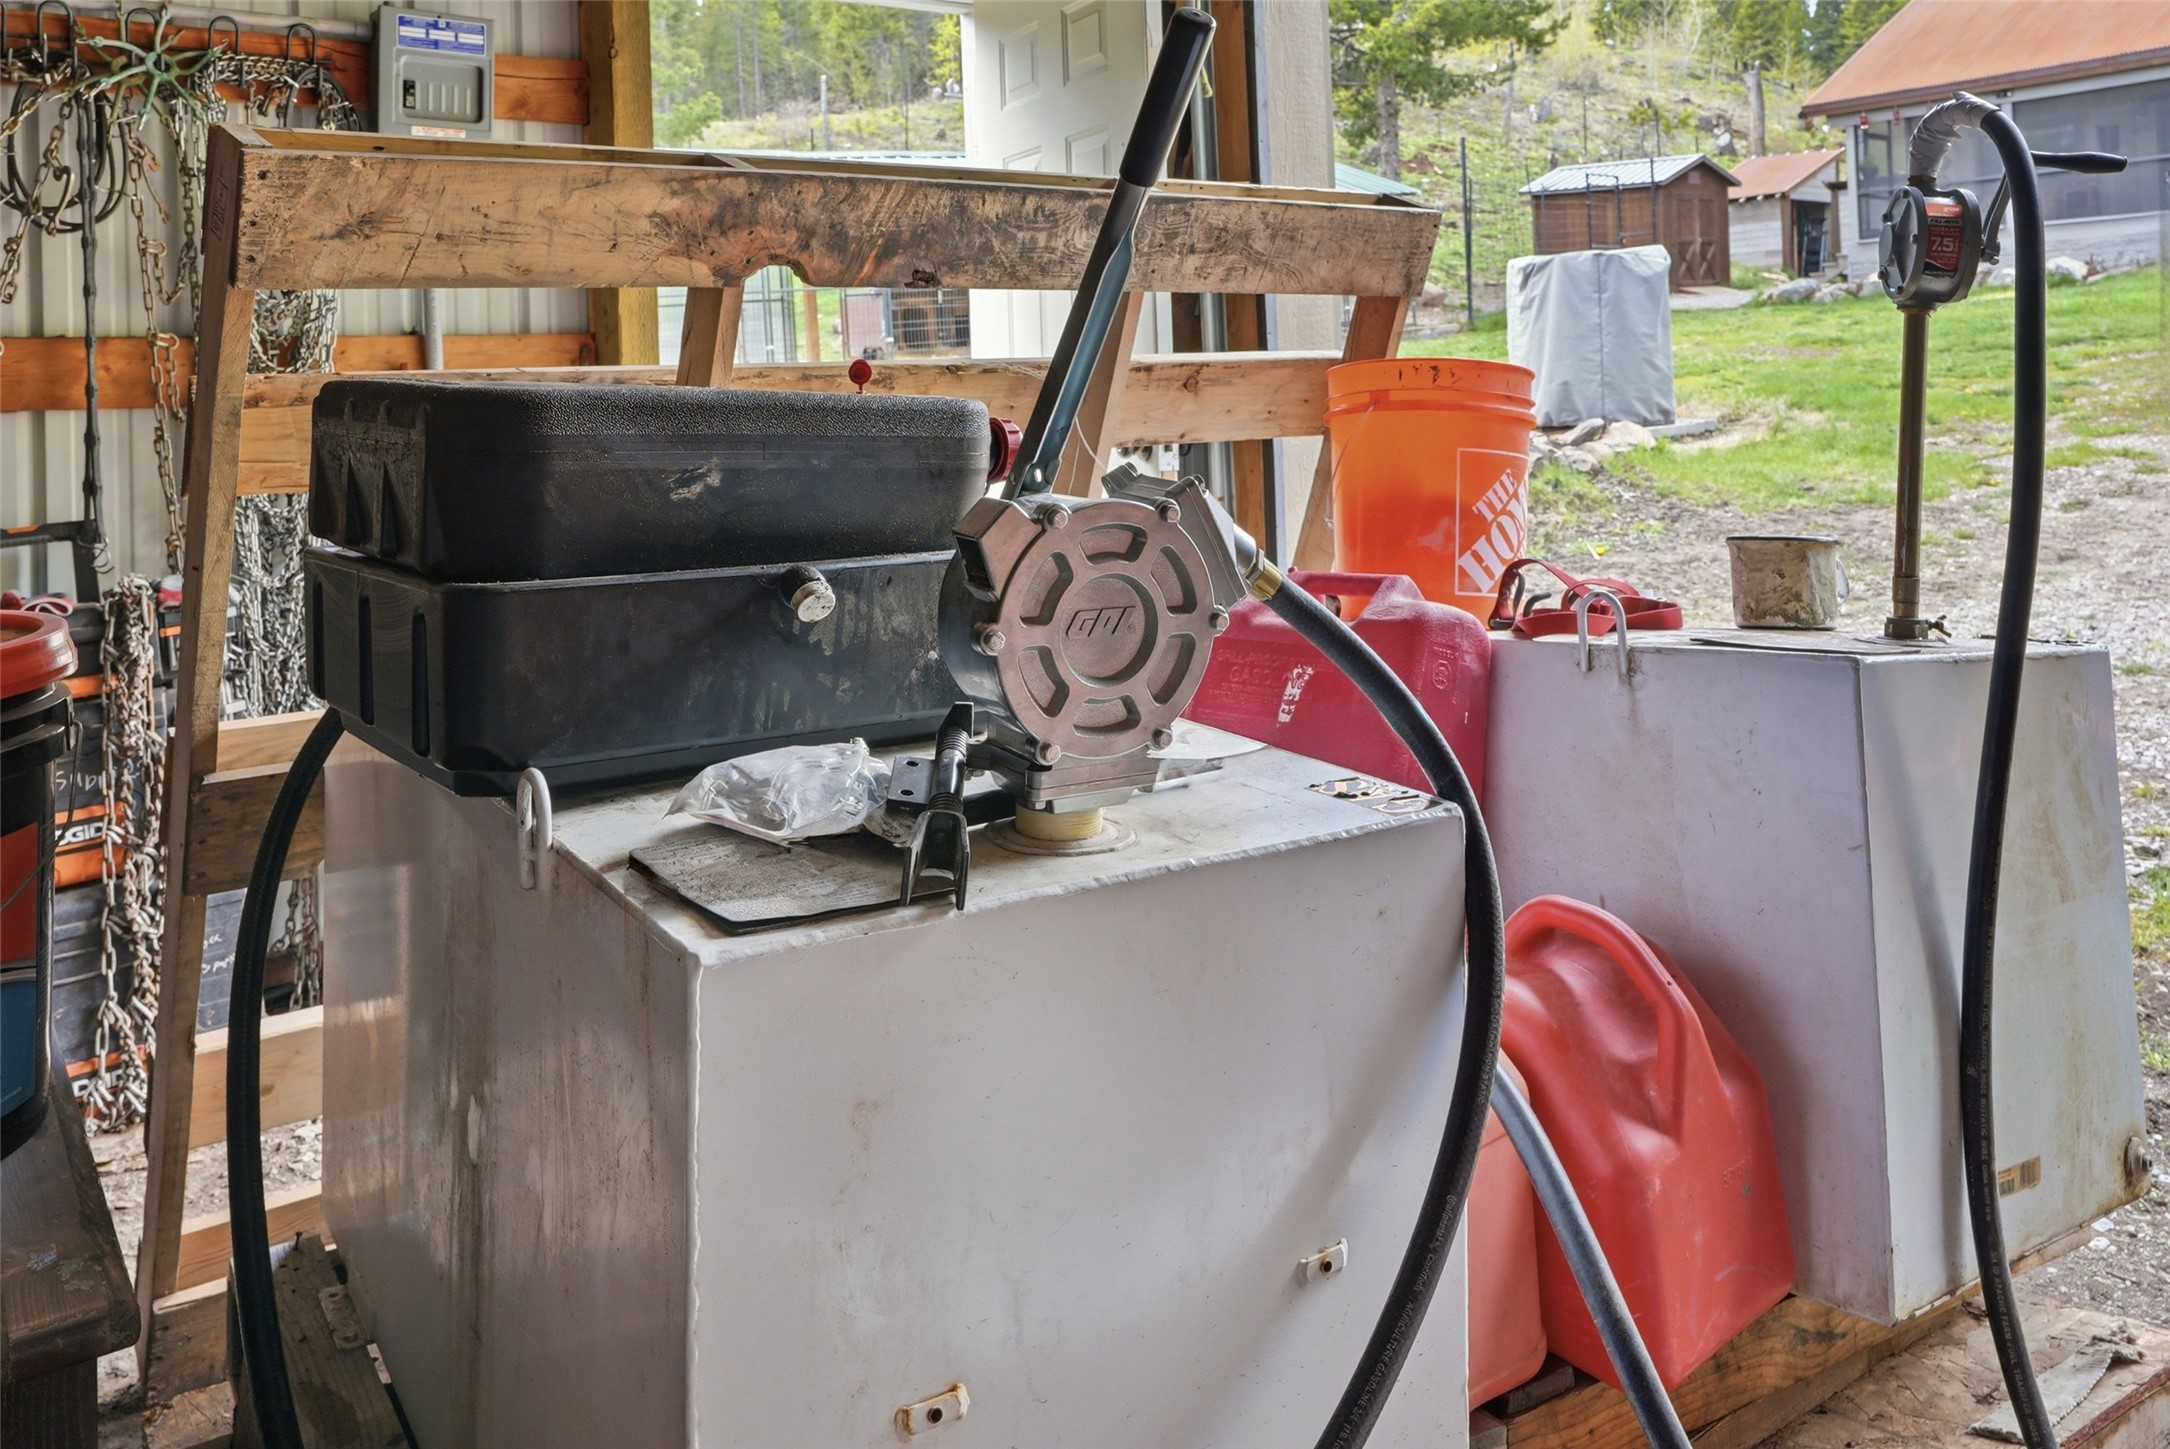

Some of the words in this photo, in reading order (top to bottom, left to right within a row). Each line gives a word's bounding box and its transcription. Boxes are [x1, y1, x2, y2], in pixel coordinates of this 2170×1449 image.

[1930, 236, 1954, 252] 7.5
[1472, 468, 1518, 523] THE
[1382, 1301, 1414, 1363] AGRICULTURE
[1358, 1362, 1385, 1407] GASOLINE
[1993, 1278, 2007, 1313] APACHE
[2000, 1316, 2012, 1340] FARM
[2006, 1343, 2018, 1365] FUEL
[2012, 1368, 2032, 1415] TRANSFER
[2026, 1418, 2041, 1443] HOSE
